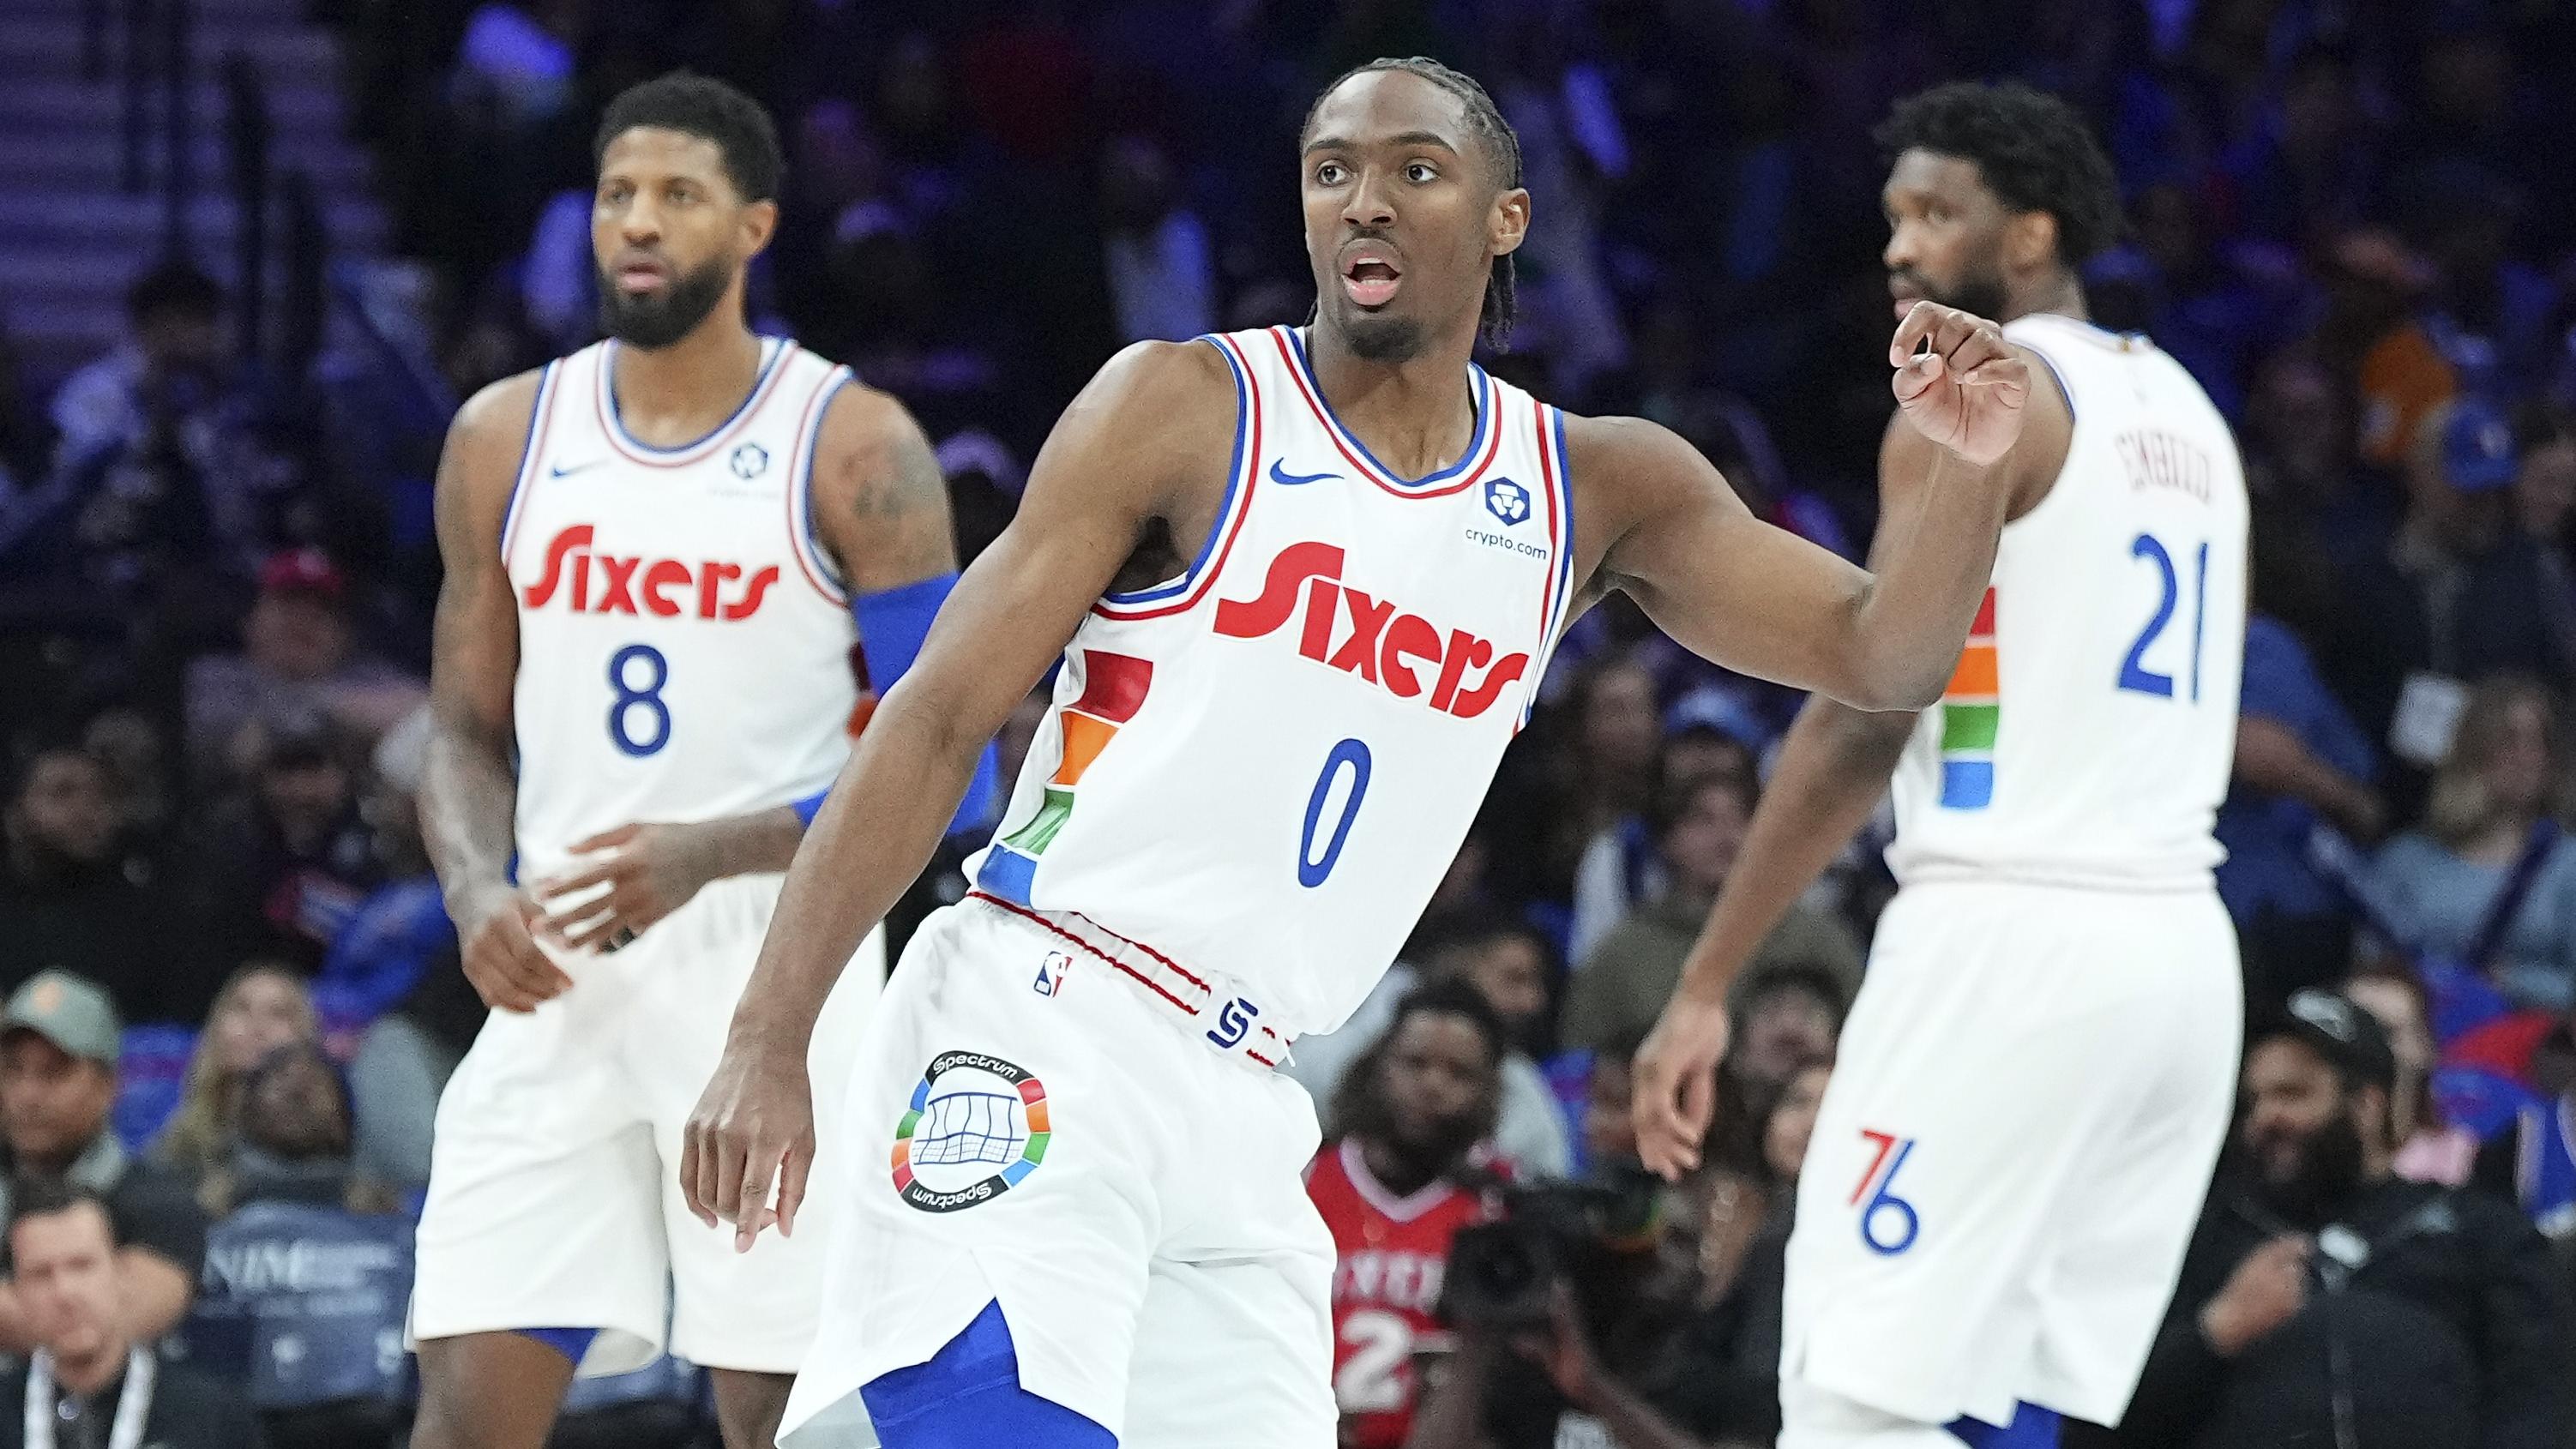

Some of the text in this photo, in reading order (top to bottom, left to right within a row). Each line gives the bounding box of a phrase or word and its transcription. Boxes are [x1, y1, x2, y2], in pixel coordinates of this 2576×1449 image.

[525, 524, 779, 622] Sixers
[1466, 528, 1547, 560] crypto.com
[1213, 541, 1530, 718] Sixers
[2116, 533, 2209, 703] 21
[607, 644, 671, 757] 8
[1297, 738, 1372, 888] 0
[932, 1054, 1019, 1079] Spectrum
[912, 1182, 992, 1209] Spectrum
[1849, 1128, 1919, 1257] 76
